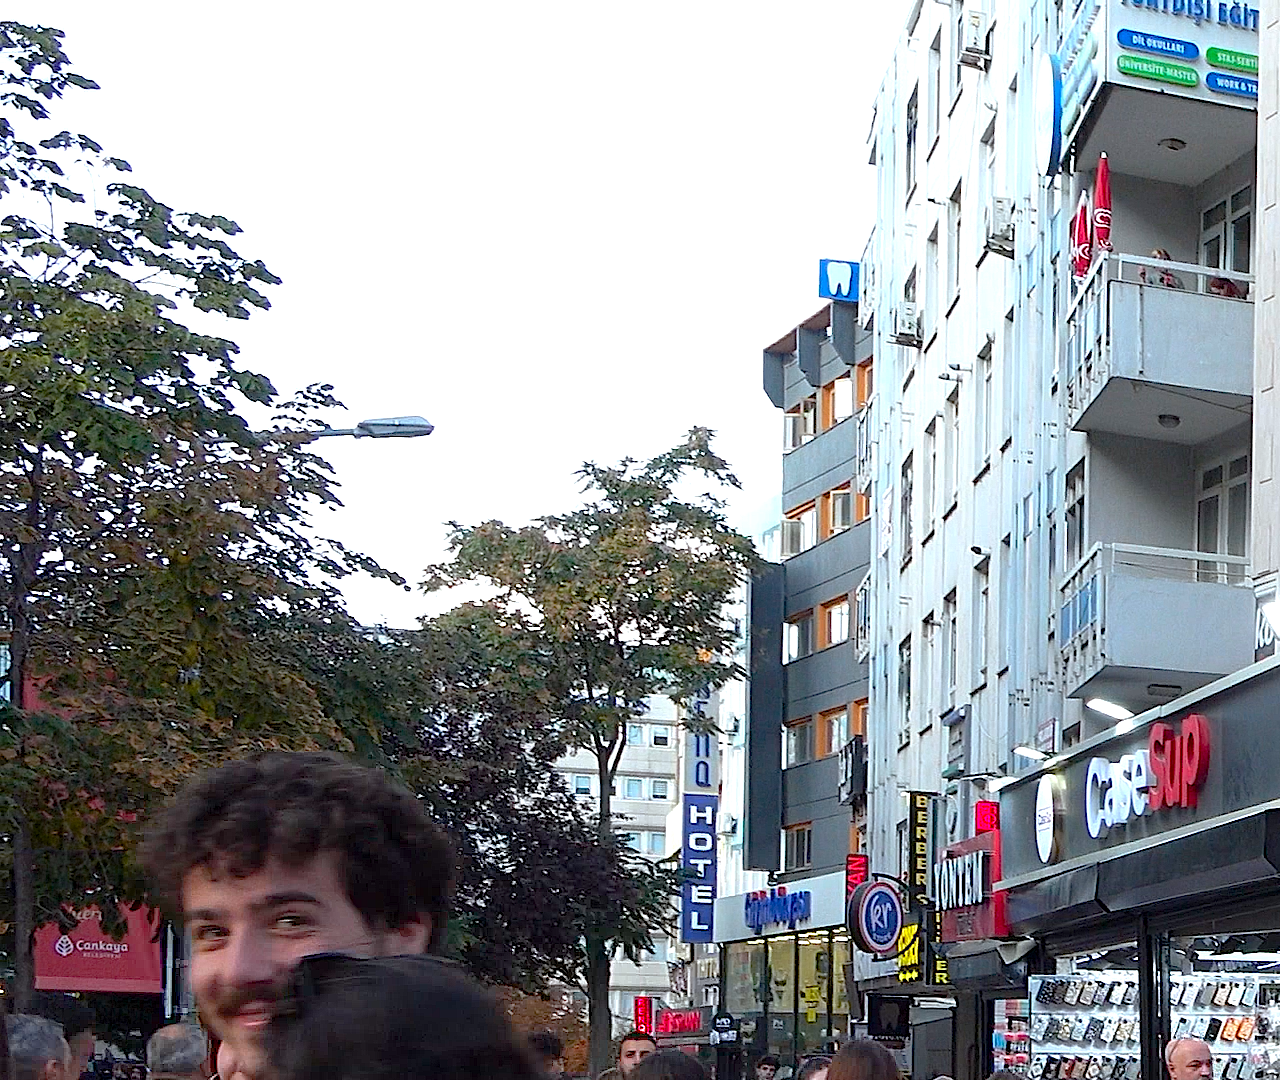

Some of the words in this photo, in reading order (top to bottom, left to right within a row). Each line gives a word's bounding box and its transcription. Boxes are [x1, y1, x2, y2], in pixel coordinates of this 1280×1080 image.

[1147, 38, 1185, 55] OKULLARI
[1086, 713, 1211, 839] CaseSup
[688, 805, 714, 931] HOTEL
[915, 795, 929, 886] BERBER
